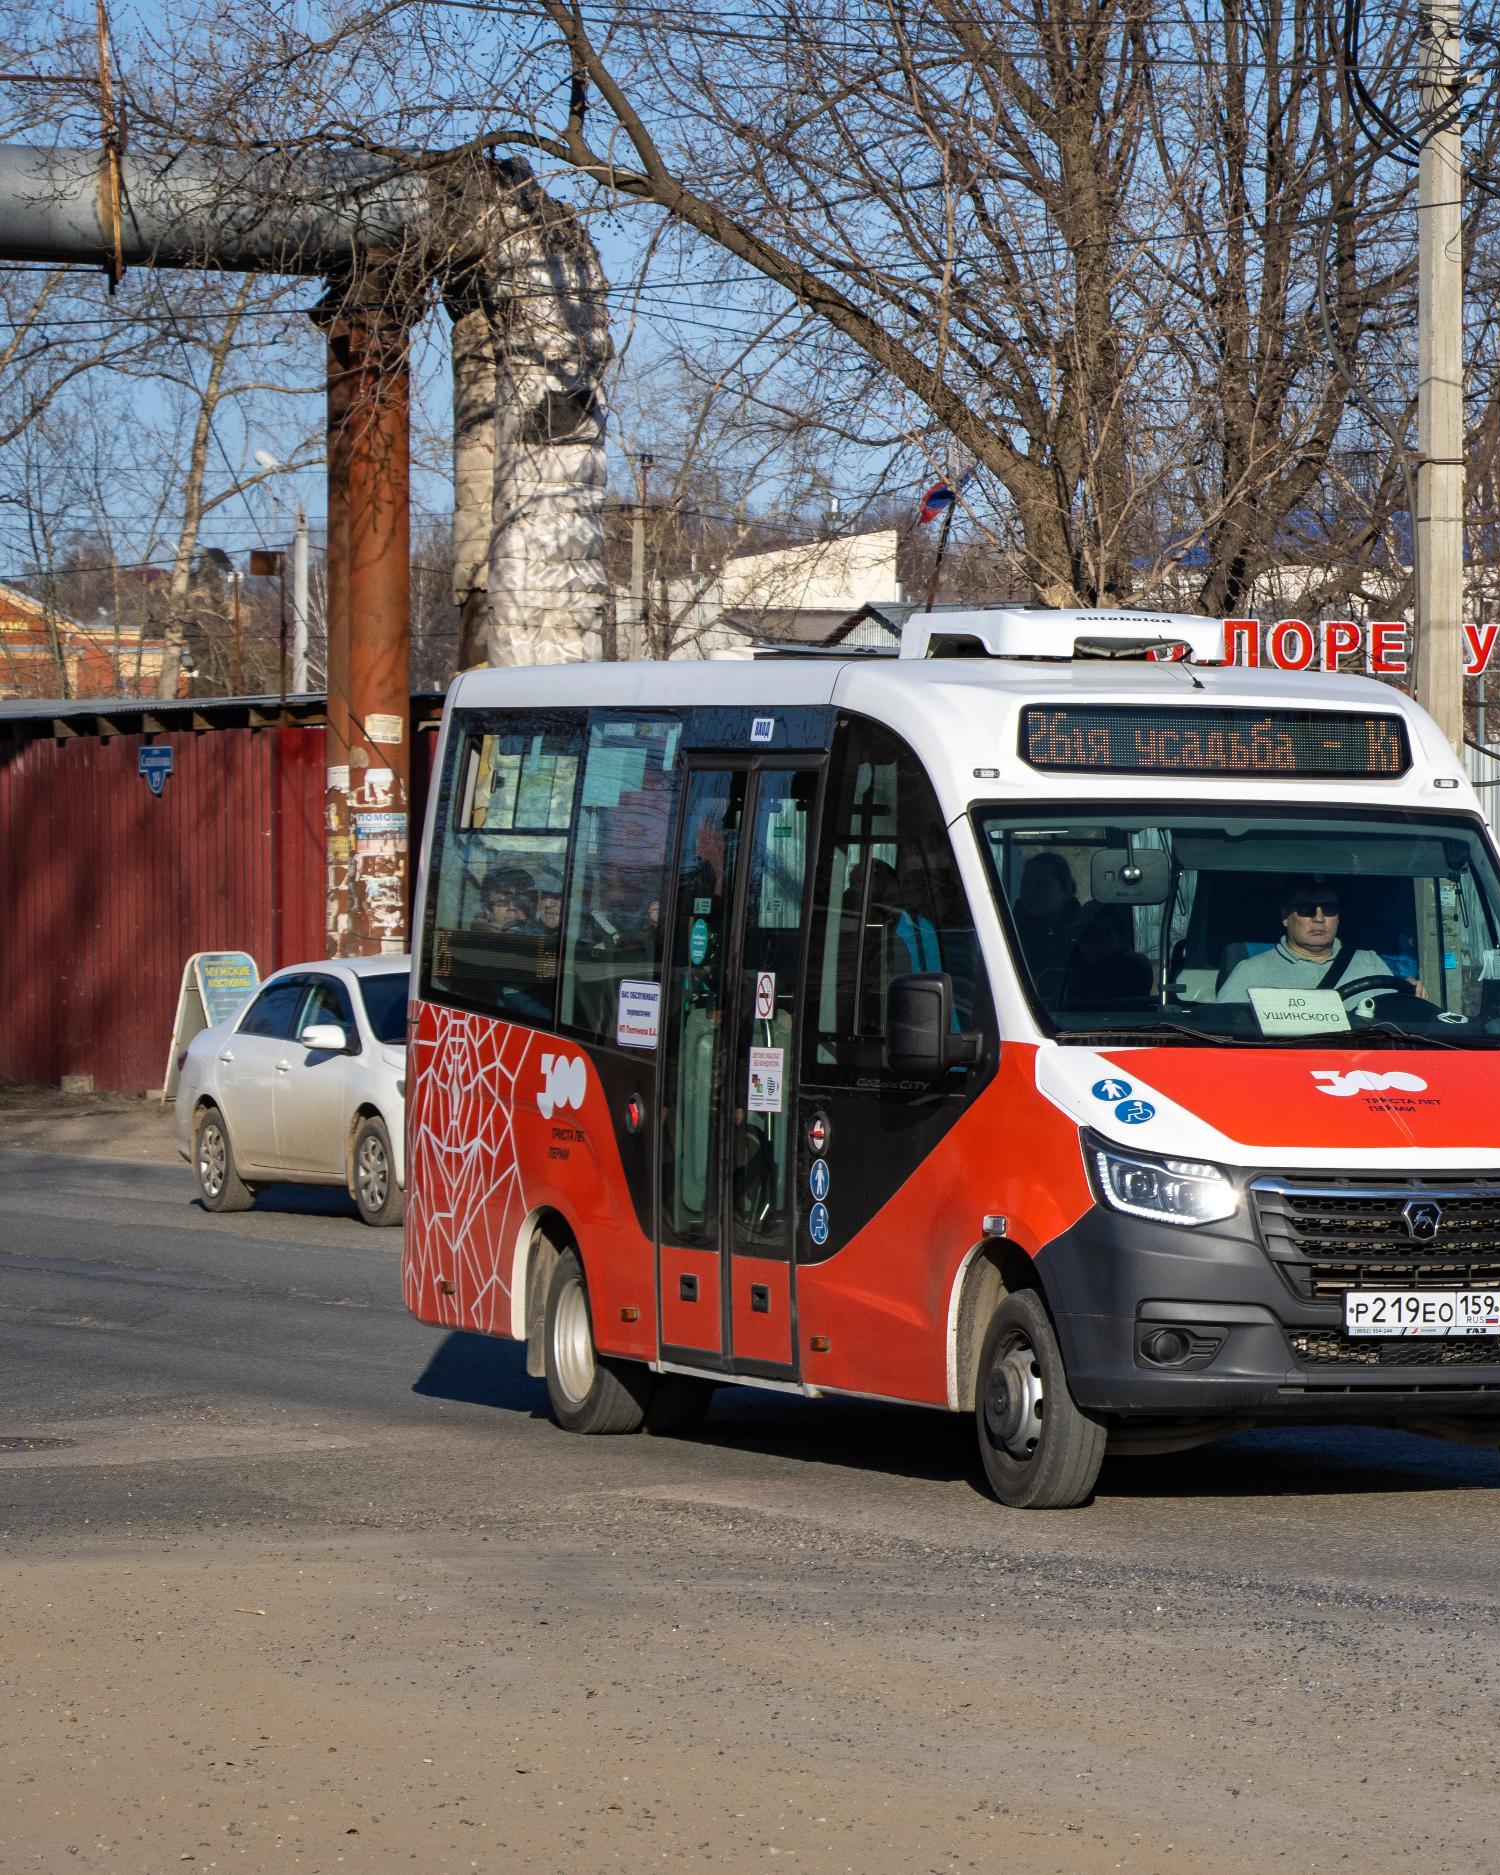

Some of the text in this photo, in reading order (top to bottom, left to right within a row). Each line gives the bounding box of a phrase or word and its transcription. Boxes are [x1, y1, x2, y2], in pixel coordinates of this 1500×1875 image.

[754, 721, 771, 738] ВХОД
[1134, 718, 1297, 769] усадьба
[1288, 998, 1306, 1008] ДО
[1262, 1011, 1341, 1022] УШИНСКОГО
[1459, 1295, 1495, 1316] 159
[1466, 1316, 1485, 1324] RUS
